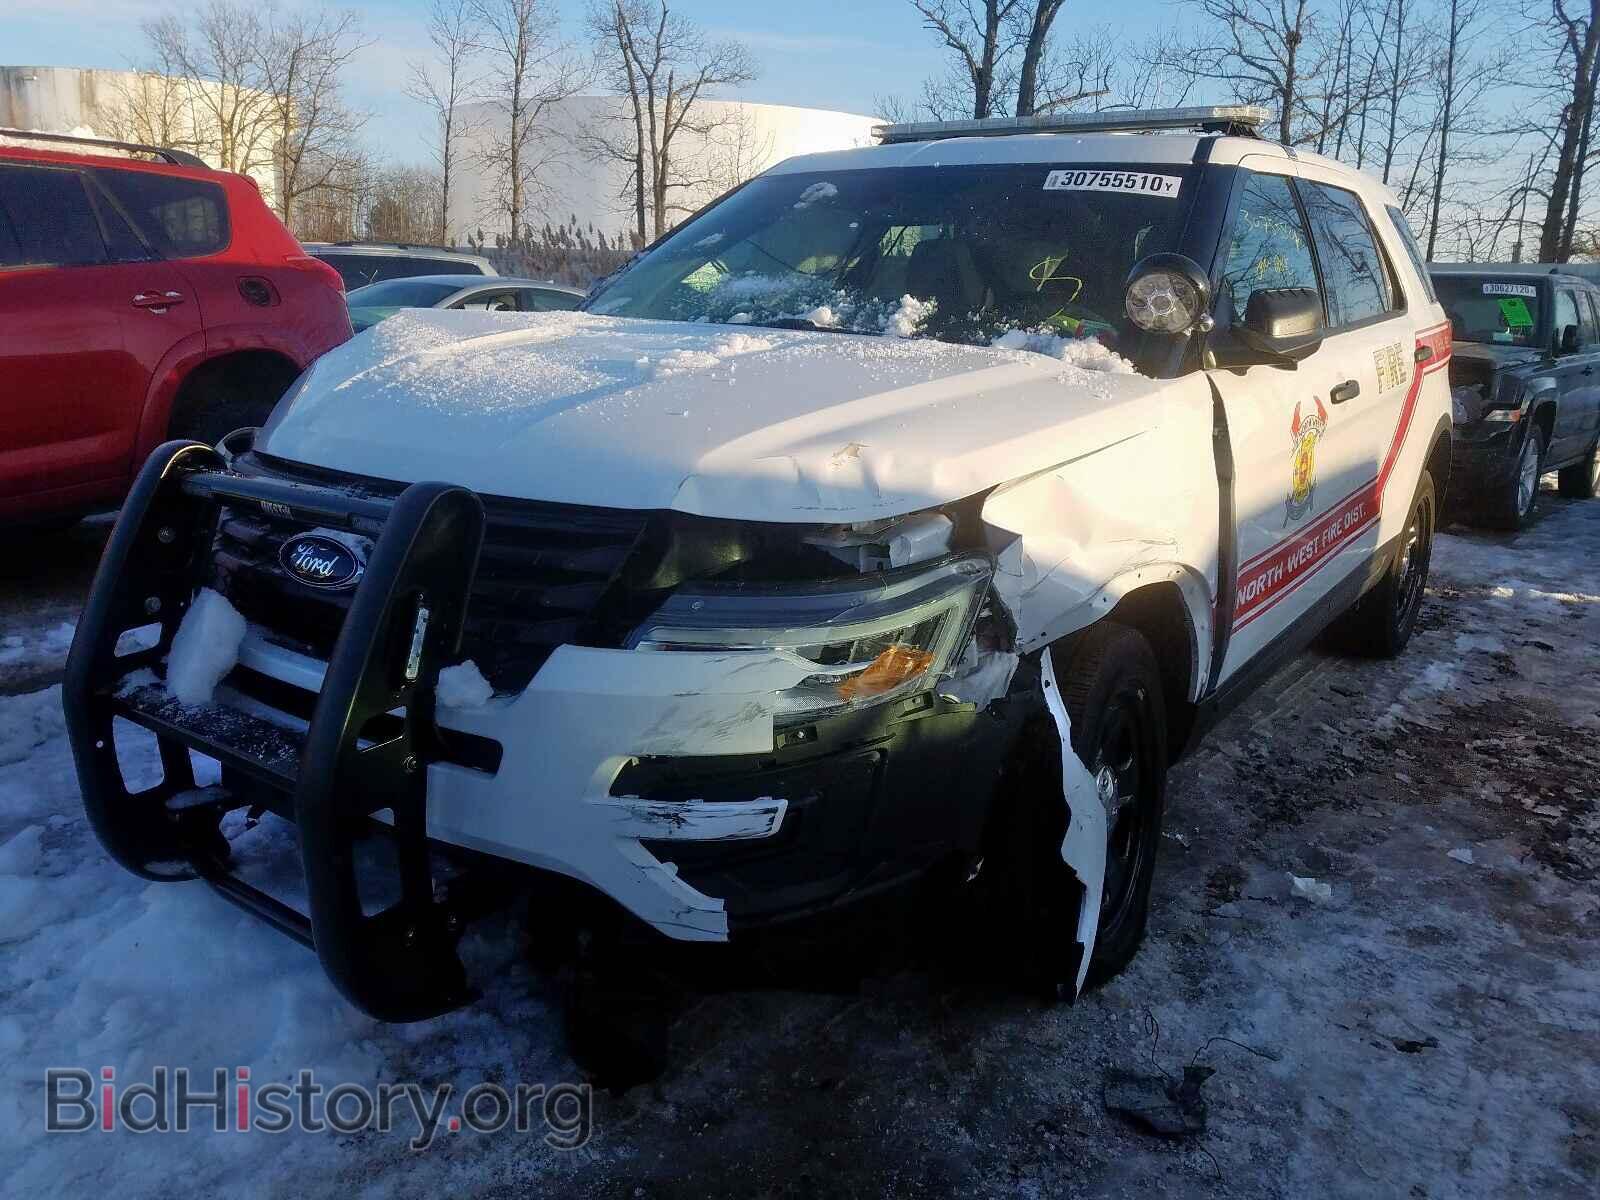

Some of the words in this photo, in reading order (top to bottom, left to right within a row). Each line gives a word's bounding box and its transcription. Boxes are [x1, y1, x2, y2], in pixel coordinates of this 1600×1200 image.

[1372, 342, 1407, 394] FIRE
[290, 543, 341, 578] Ford
[1235, 561, 1284, 610] NORTH
[1287, 536, 1320, 574] WEST
[1321, 518, 1343, 548] FIRE
[1344, 502, 1367, 530] DIST.
